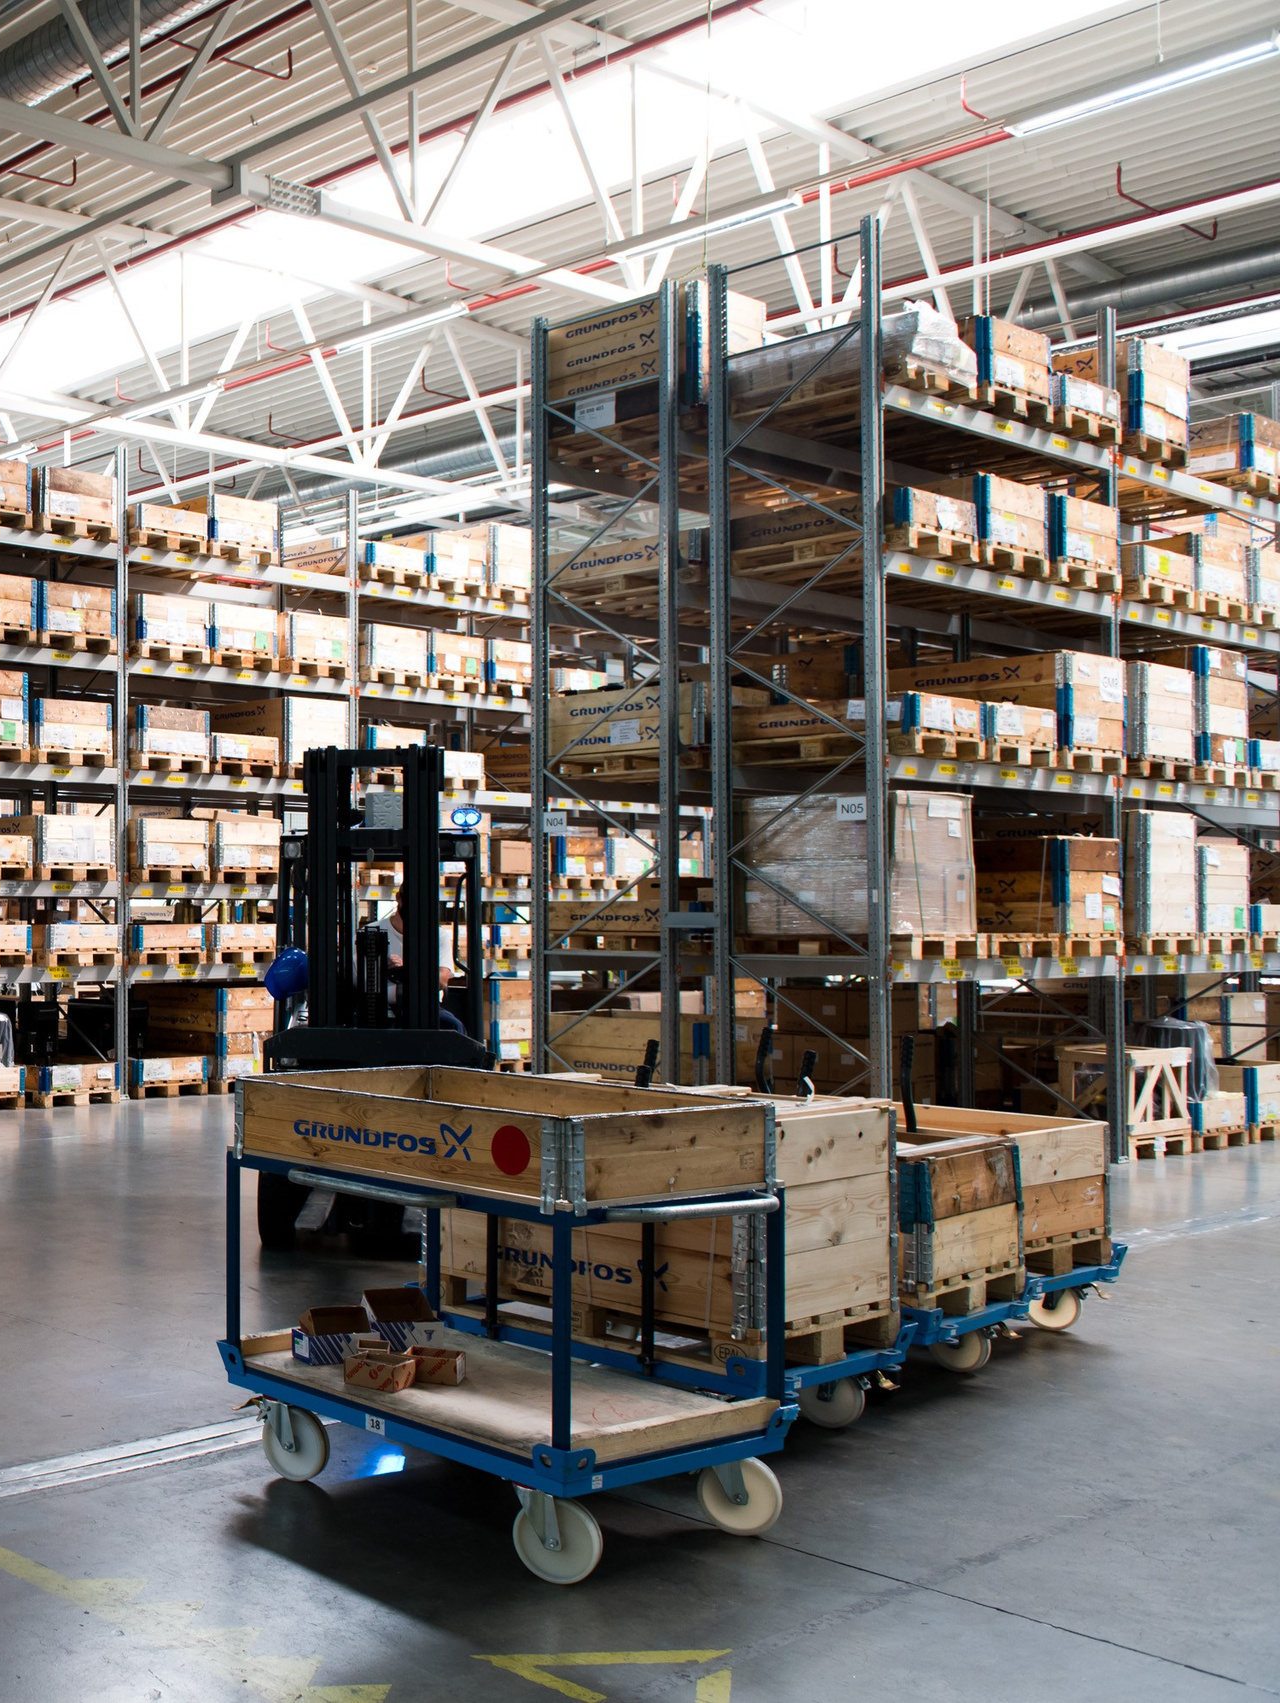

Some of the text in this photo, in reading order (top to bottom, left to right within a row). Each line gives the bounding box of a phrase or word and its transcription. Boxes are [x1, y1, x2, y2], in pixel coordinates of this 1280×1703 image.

[566, 310, 638, 339] GRUNDFOS
[566, 343, 636, 368] GRUNDFOS
[568, 372, 637, 396] GRUNDFOS
[751, 517, 834, 538] GRUNDFOS
[298, 556, 338, 568] GRUNDFOS
[570, 551, 644, 570] GRUNDFOS
[915, 674, 1000, 688] GRUNDFOS
[841, 804, 864, 814] N05
[546, 818, 563, 826] N04
[574, 1061, 638, 1073] GRUNDFO
[293, 1119, 437, 1156] GRUNDFOS
[370, 1418, 380, 1430] 18
